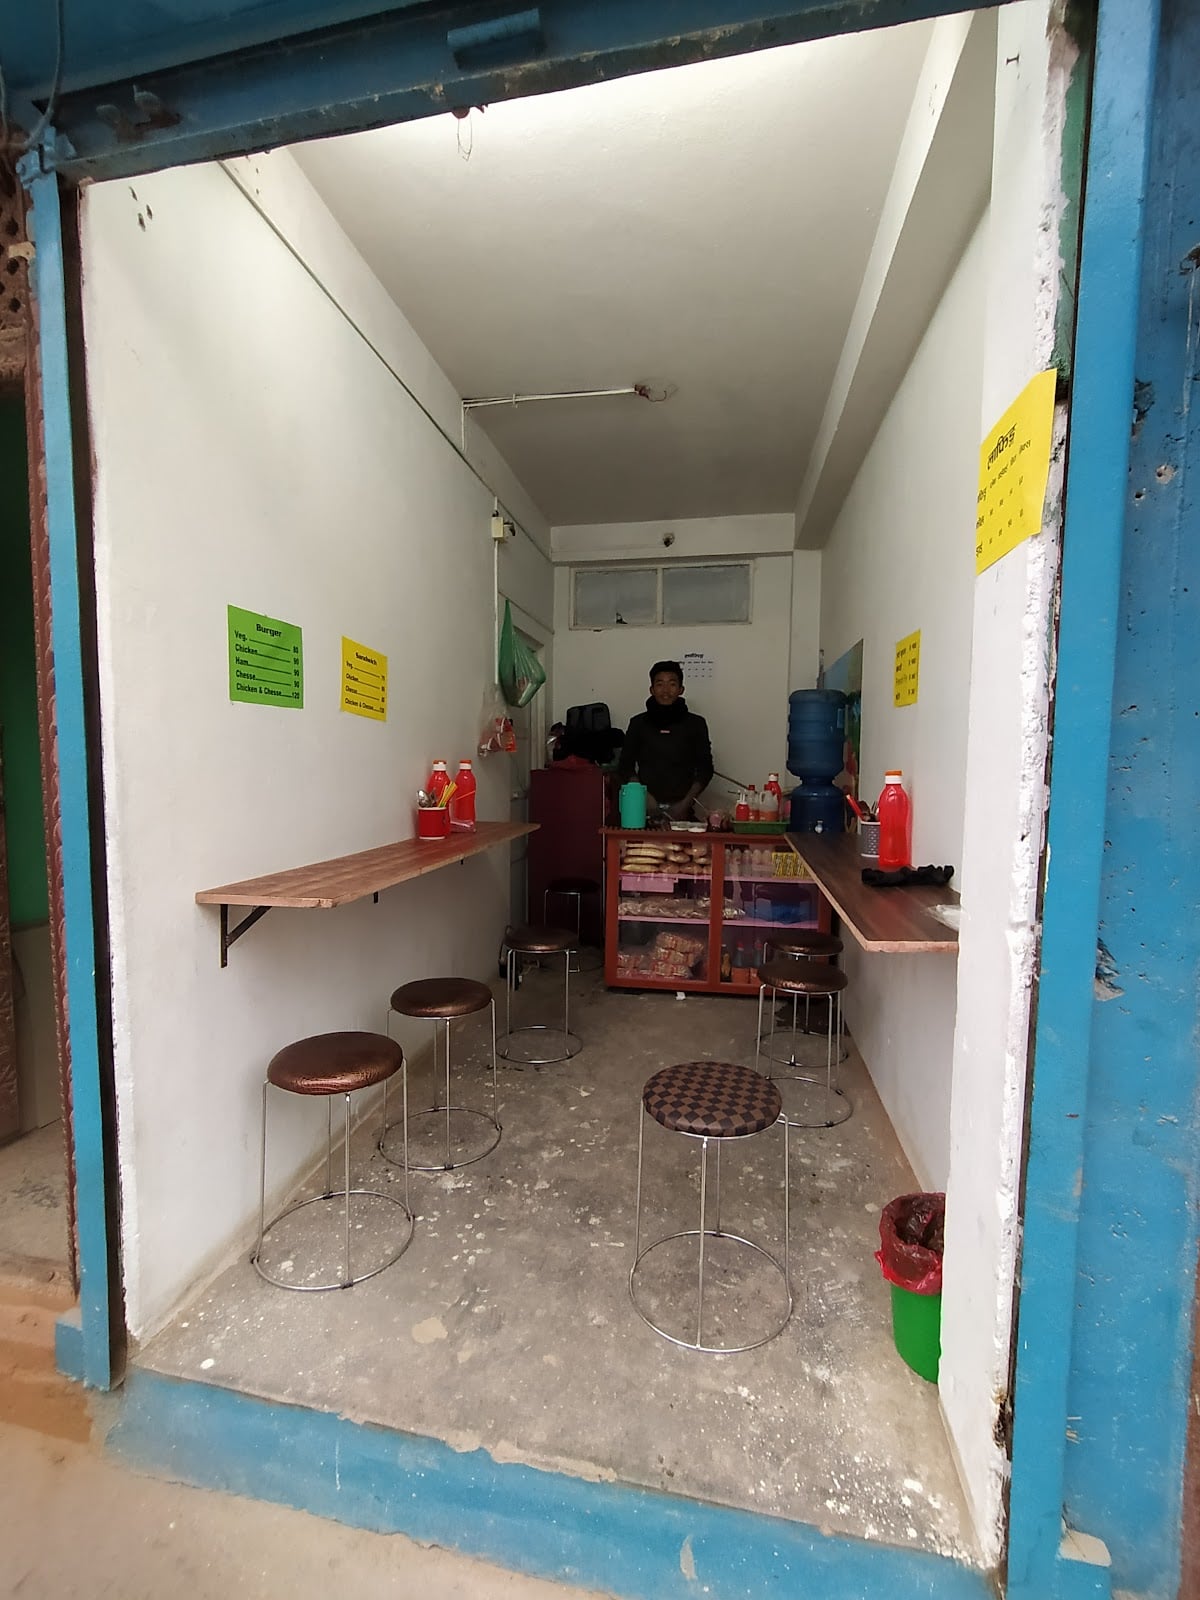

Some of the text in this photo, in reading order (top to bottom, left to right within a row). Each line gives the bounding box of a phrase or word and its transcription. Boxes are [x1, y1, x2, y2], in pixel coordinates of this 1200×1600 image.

[234, 630, 248, 642] Veg.
[256, 623, 282, 637] Burger
[235, 643, 258, 655] Chicken
[235, 656, 249, 665] Ham
[355, 652, 378, 666] Sandwich
[345, 673, 359, 682] Chicken
[236, 683, 258, 693] Chicken
